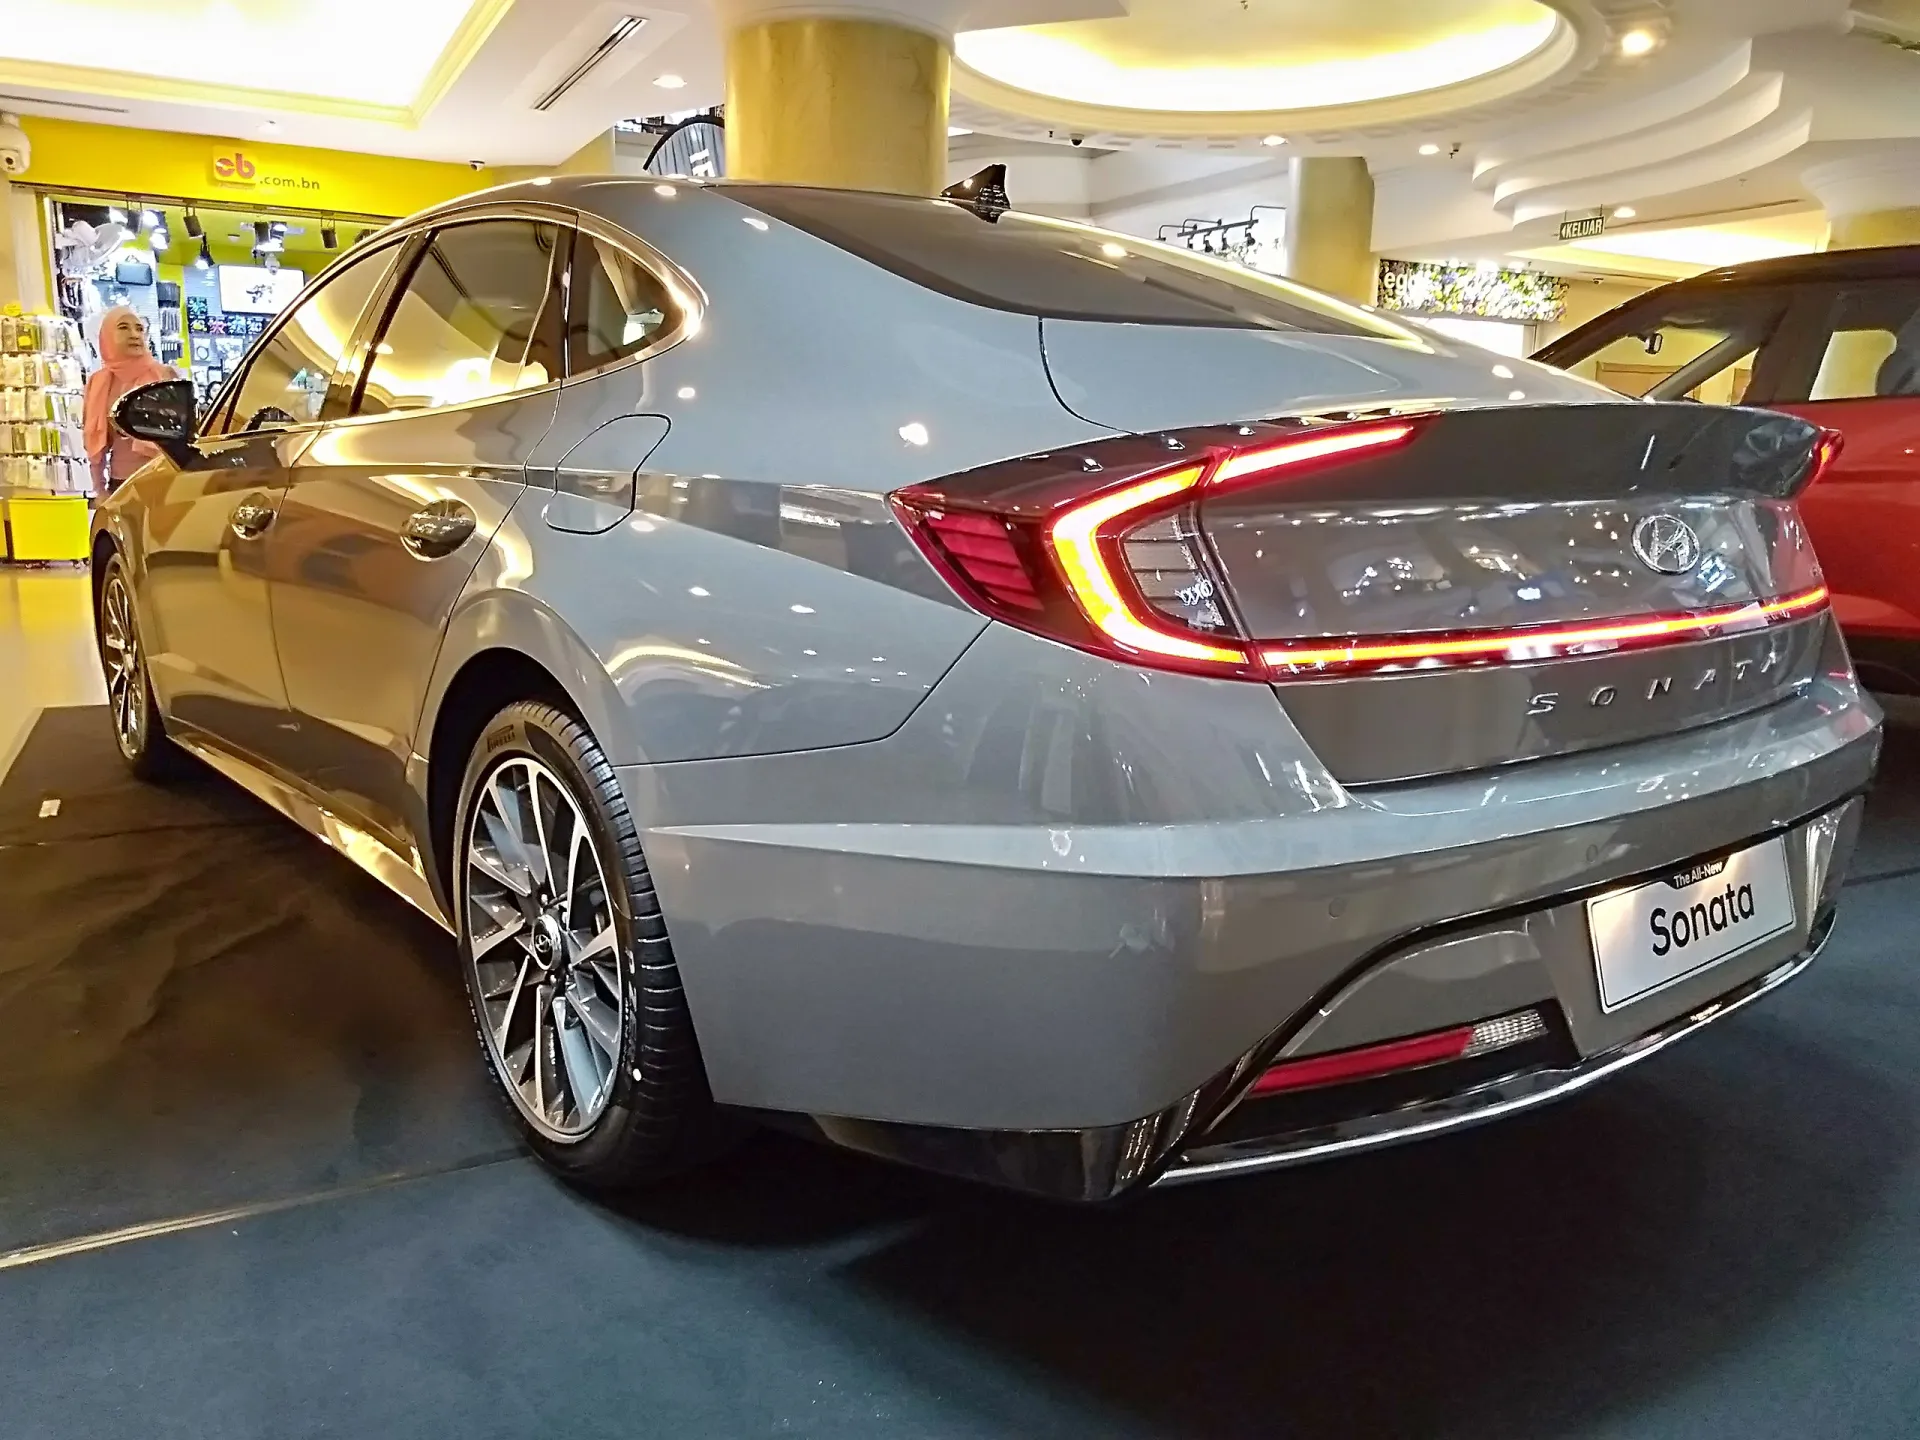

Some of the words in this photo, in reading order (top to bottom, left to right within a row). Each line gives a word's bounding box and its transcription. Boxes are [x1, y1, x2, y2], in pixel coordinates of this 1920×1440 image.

[1565, 218, 1603, 239] KELUAR
[1526, 650, 1777, 715] SONATA
[1673, 873, 1691, 888] The
[1691, 861, 1723, 882] All-New
[1650, 883, 1755, 956] Sonata
